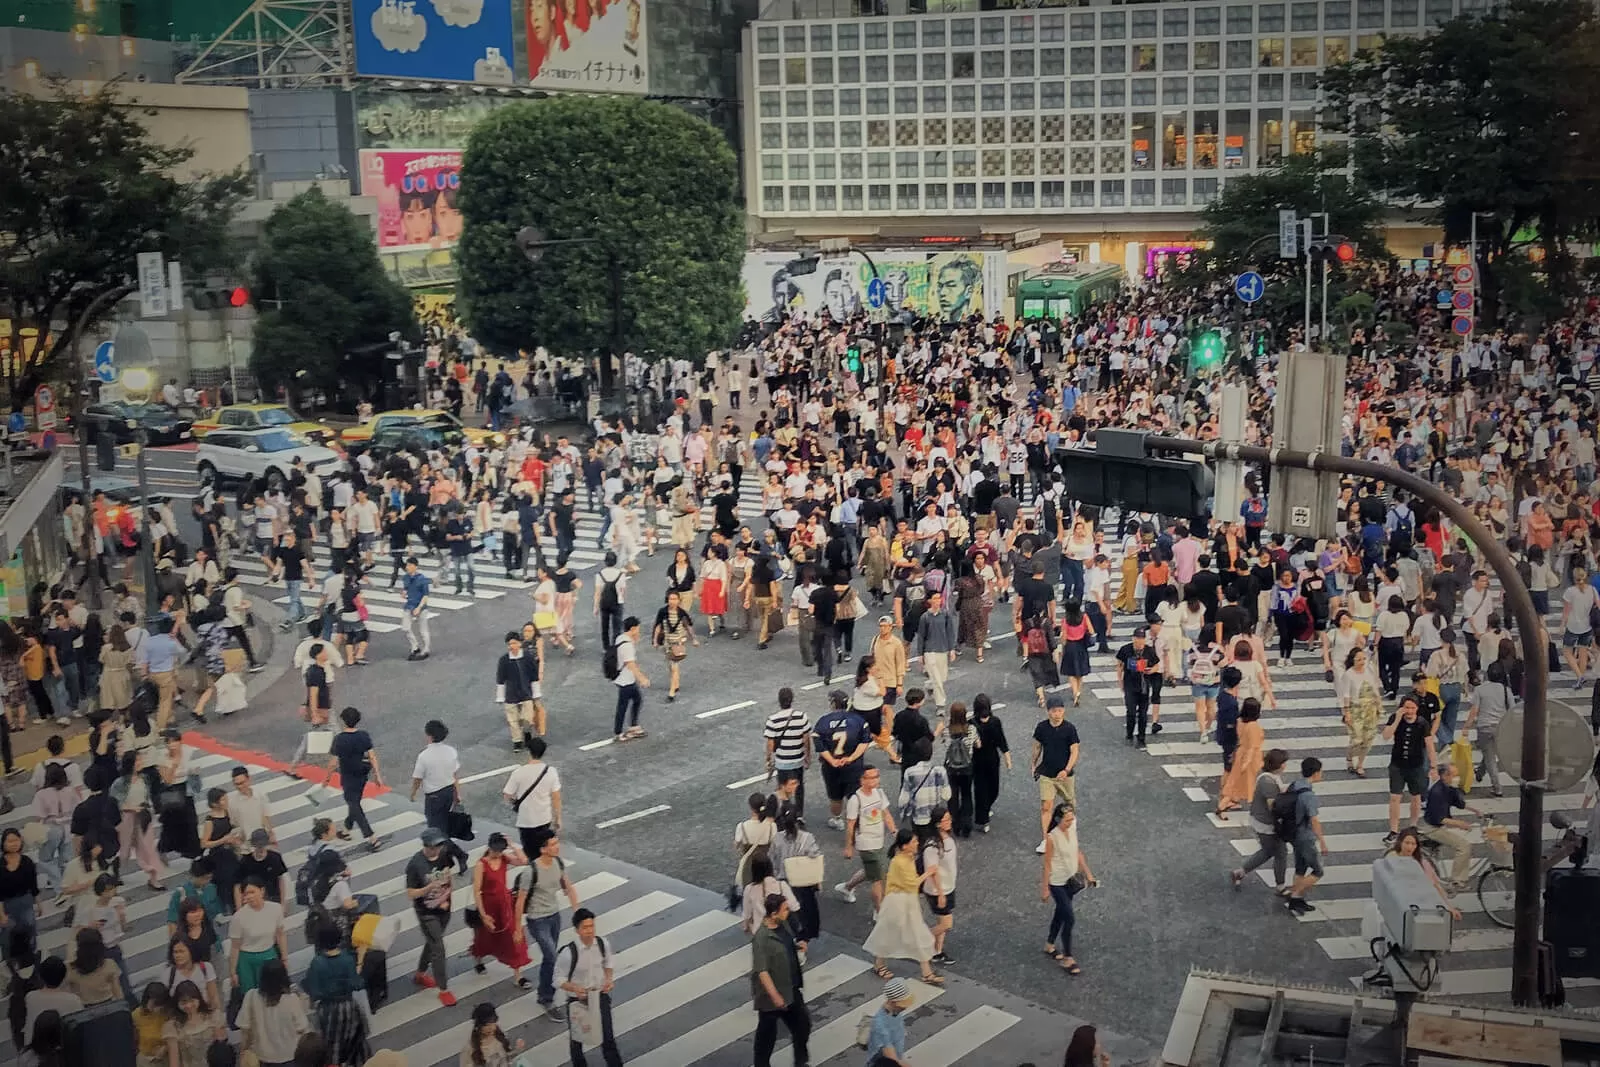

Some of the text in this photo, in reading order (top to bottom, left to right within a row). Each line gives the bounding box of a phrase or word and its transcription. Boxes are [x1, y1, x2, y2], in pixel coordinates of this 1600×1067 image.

[583, 60, 627, 83] イチナナ
[832, 731, 848, 756] 7
